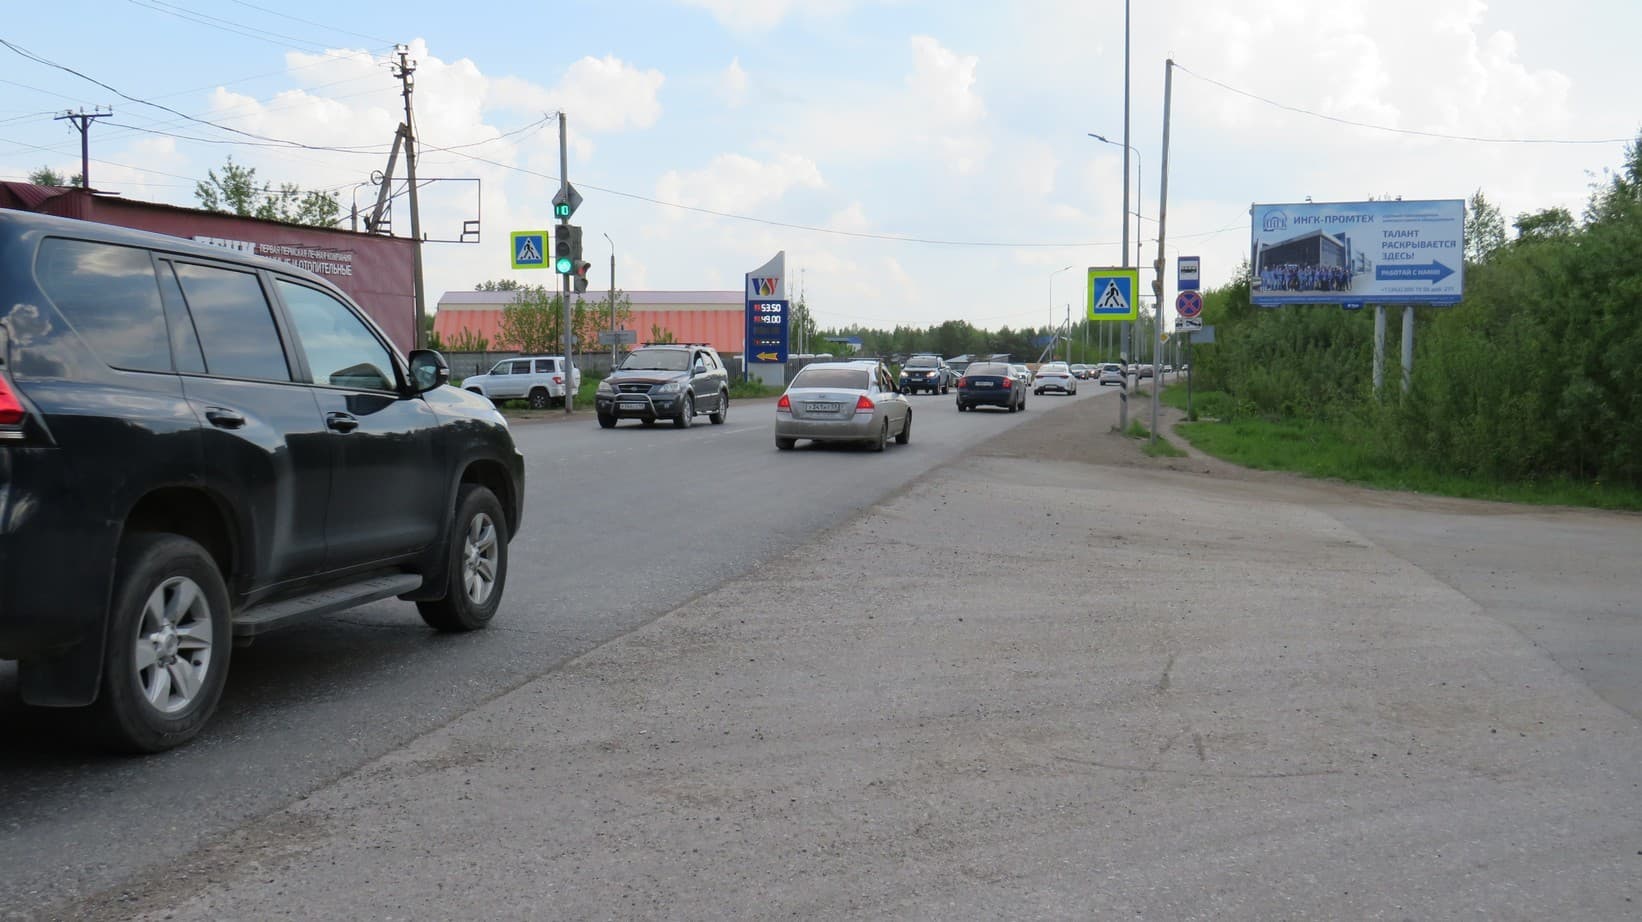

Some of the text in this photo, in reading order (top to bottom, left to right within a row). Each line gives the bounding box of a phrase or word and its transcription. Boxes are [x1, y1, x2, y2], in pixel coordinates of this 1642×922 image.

[556, 205, 569, 216] 10
[1293, 214, 1374, 224] ИНГК-ПРОМТЕХ
[1383, 230, 1419, 238] ТАЛАНТ
[1382, 240, 1456, 248] РАСКРЫВАЕТСЯ
[260, 244, 280, 254] ПЕРВАЯ
[280, 246, 307, 258] ПЕРМСКАЯ
[307, 248, 327, 260] ПЕЧНАЯ
[328, 252, 352, 262] КОМПАНИЯ
[1382, 252, 1415, 261] ЗДЕСЬ!
[298, 260, 353, 275] ОТОПИТЕЛЬНЫЕ
[761, 303, 781, 312] 53.50
[761, 315, 781, 323] 49.00
